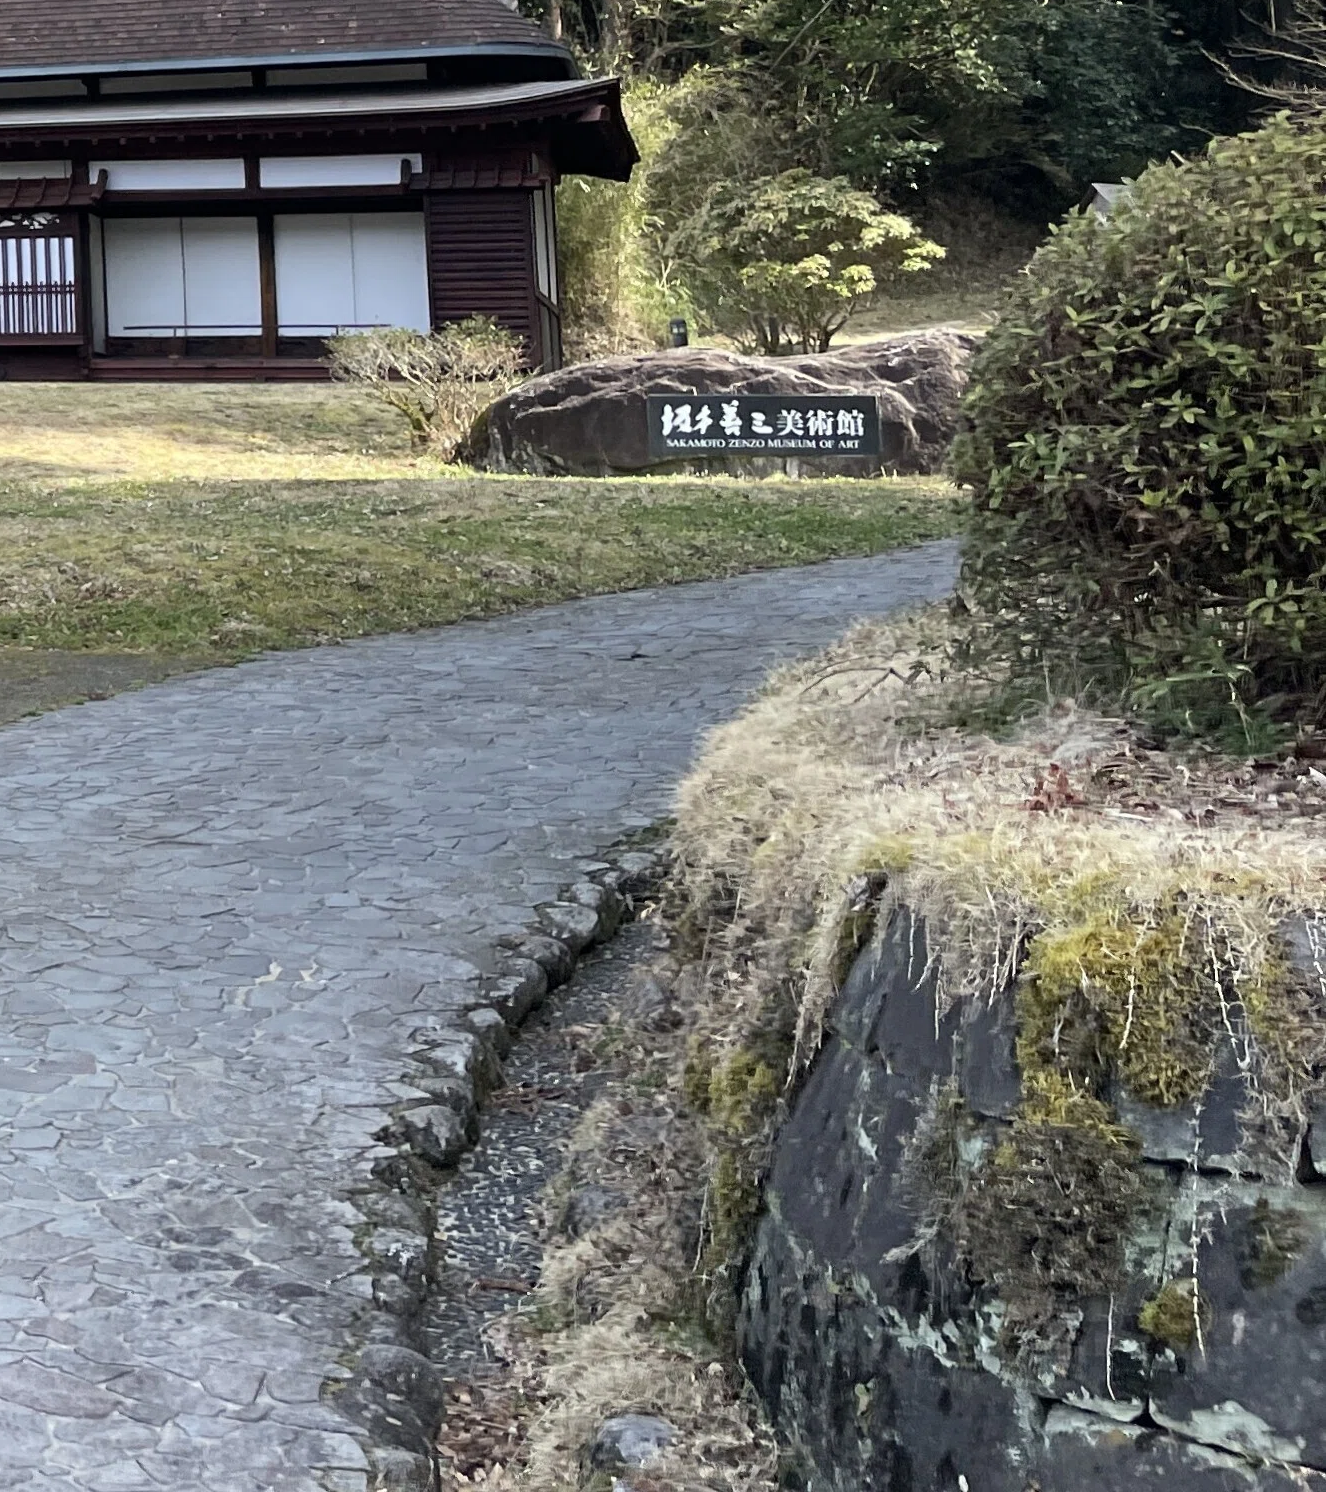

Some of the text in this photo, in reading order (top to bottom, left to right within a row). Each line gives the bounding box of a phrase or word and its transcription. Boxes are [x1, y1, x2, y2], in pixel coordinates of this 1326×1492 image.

[661, 399, 865, 437] 坂本善三美術館
[666, 438, 860, 450] SAKAMOTO ZENZO MUSEUM OF ART
